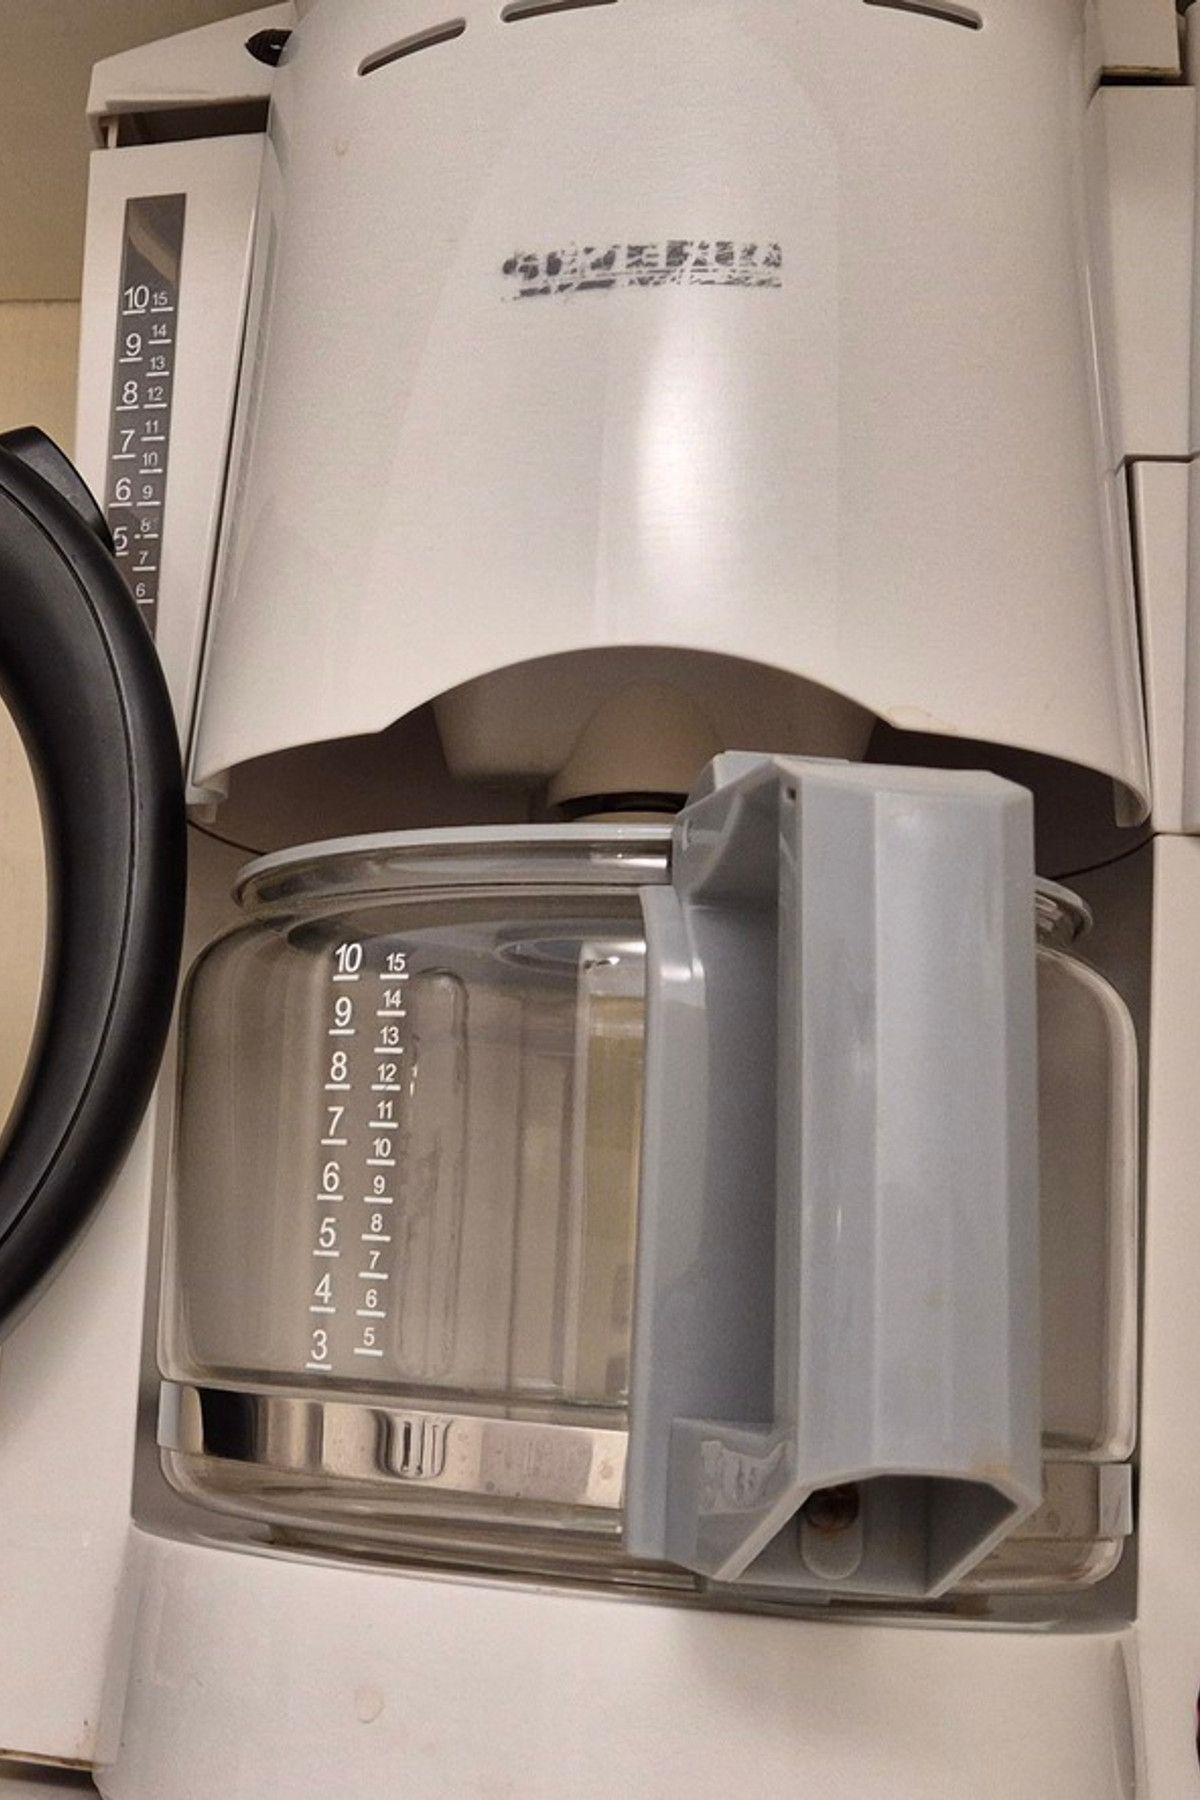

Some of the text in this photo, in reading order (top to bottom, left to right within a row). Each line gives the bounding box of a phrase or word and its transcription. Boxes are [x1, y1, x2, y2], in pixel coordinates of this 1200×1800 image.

[124, 284, 149, 309] 10
[153, 290, 168, 306] 15
[151, 324, 167, 338] 14
[125, 333, 142, 357] 9
[150, 355, 165, 371] 13
[122, 380, 138, 405] 8
[147, 386, 163, 401] 12
[145, 419, 159, 434] 11
[120, 430, 135, 452] 7
[142, 452, 158, 467] 10
[115, 477, 131, 501] 6
[142, 485, 153, 500] 9
[139, 519, 150, 533] 8
[113, 526, 128, 550] 5
[139, 551, 149, 565] 7
[136, 582, 145, 598] 6
[335, 942, 363, 973] 10
[386, 952, 406, 971] 15
[383, 989, 402, 1008] 14
[334, 996, 352, 1027] 9
[380, 1026, 399, 1045] 13
[330, 1051, 347, 1082] 8
[377, 1063, 397, 1082] 12
[377, 1100, 393, 1119] 11
[327, 1106, 345, 1137] 7
[373, 1138, 391, 1157] 10
[322, 1161, 340, 1192] 6
[373, 1175, 385, 1195] 9
[370, 1213, 383, 1232] 8
[318, 1217, 337, 1248] 5
[369, 1251, 381, 1270] 7
[314, 1272, 332, 1304] 4
[365, 1289, 377, 1308] 6
[311, 1329, 328, 1361] 3
[363, 1327, 375, 1347] 5
